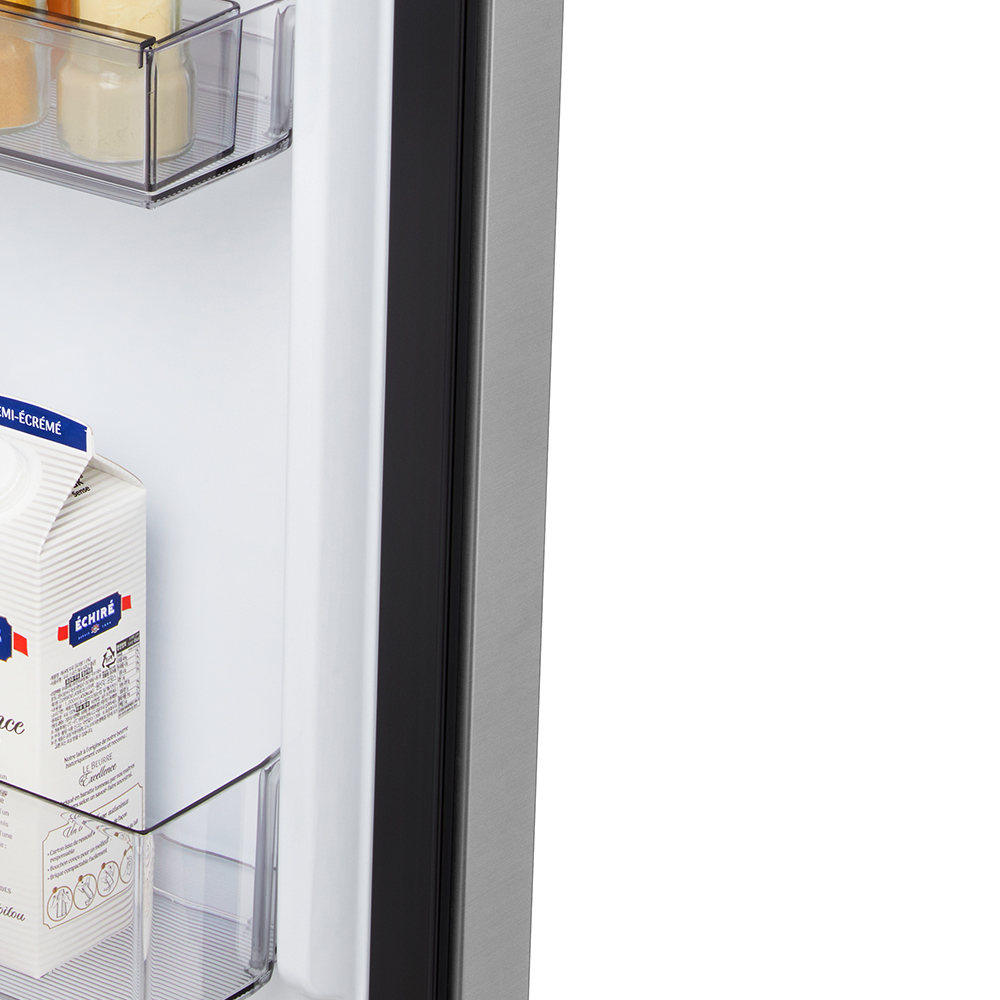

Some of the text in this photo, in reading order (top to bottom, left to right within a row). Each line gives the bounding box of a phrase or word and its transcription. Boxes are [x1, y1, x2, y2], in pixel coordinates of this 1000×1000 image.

[71, 485, 91, 498] Sense
[74, 599, 116, 632] ÉCHIRÉ
[82, 753, 113, 774] LE BEURRE
[0, 884, 12, 894] DES
